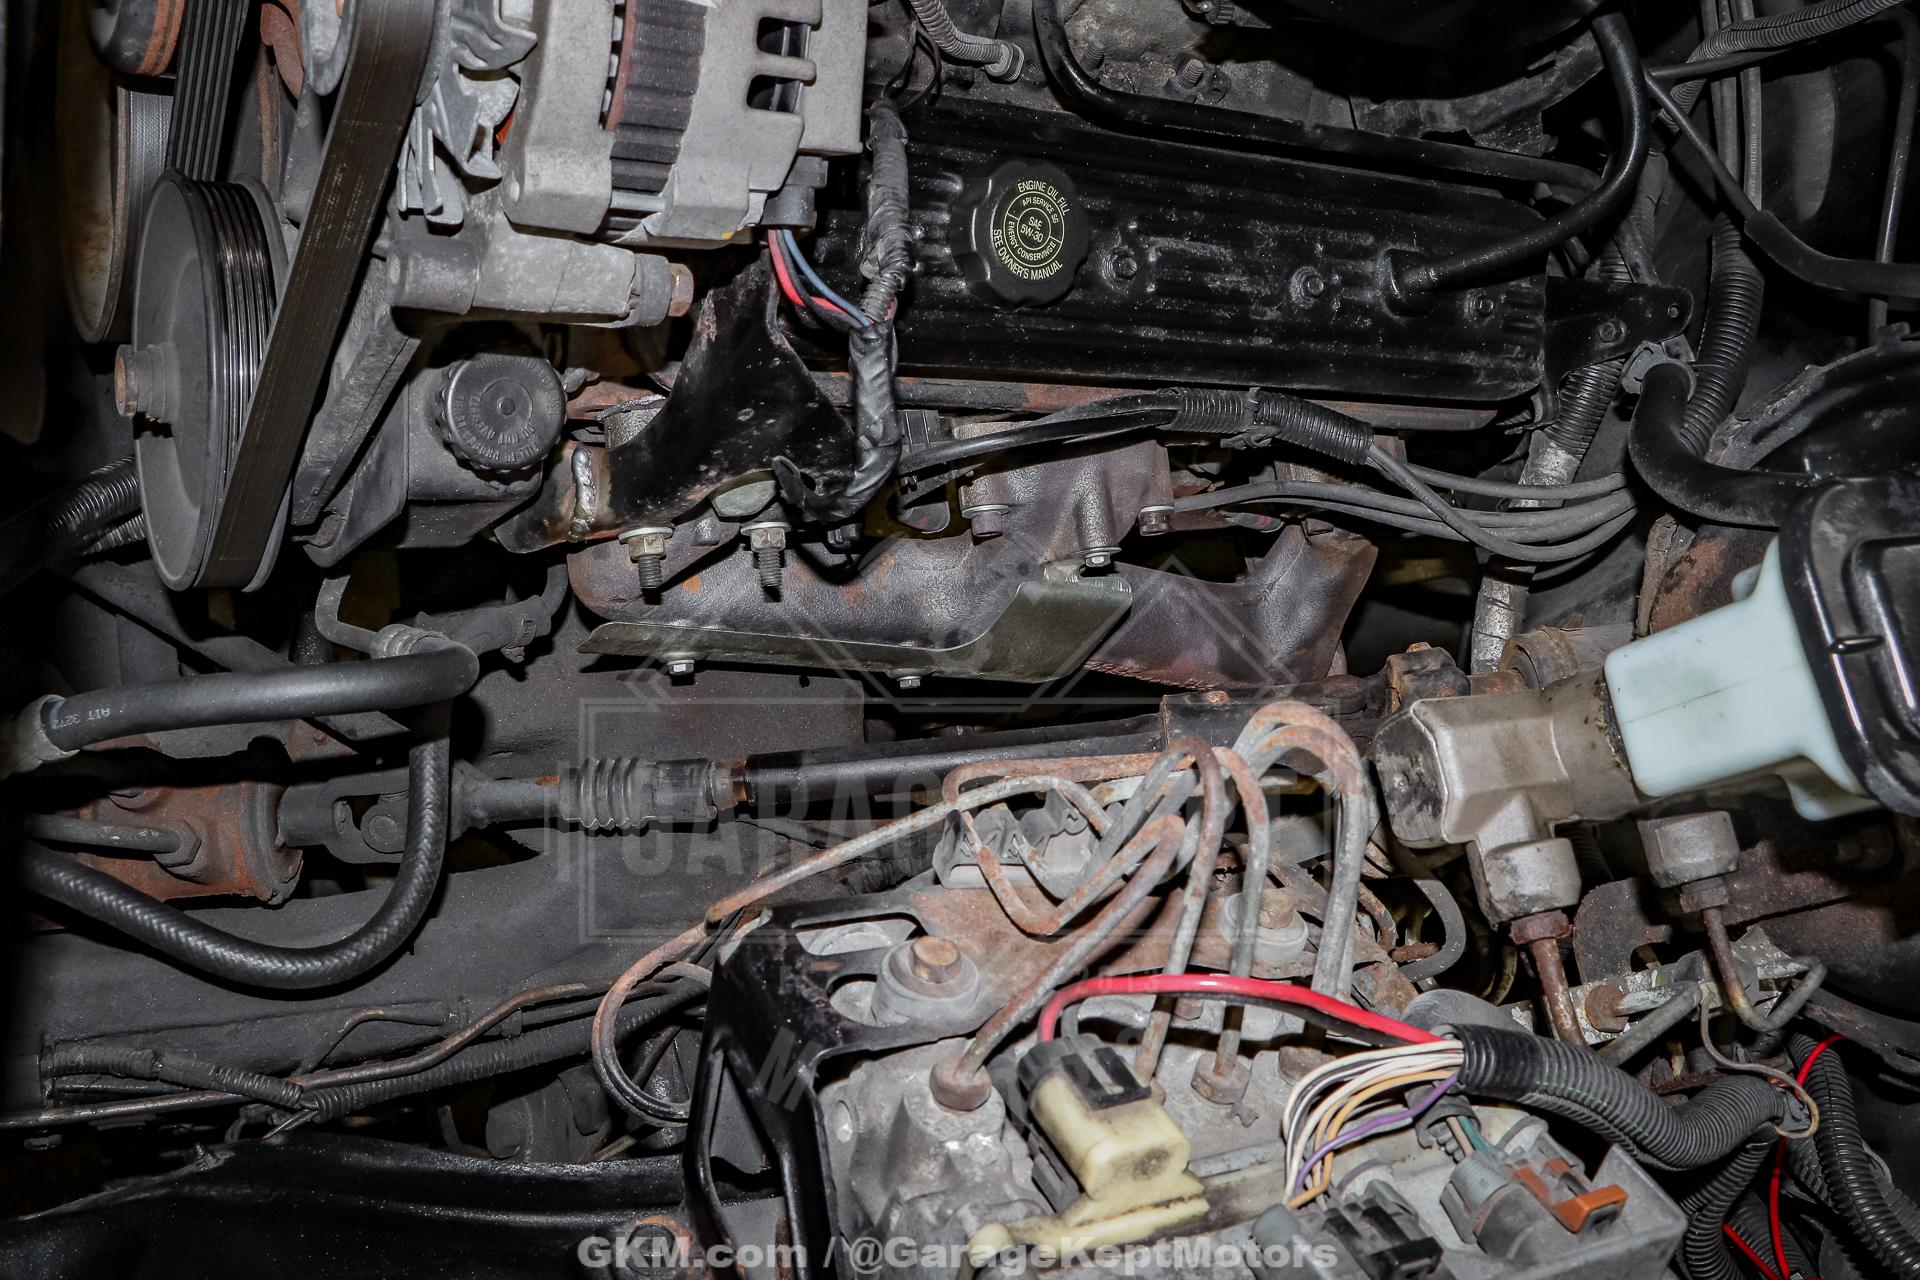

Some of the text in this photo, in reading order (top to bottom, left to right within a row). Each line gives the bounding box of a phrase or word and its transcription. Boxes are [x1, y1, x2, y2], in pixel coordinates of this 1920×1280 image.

[1017, 180, 1070, 217] ENGINE OIL FILL
[1022, 196, 1059, 224] API SERVICE SG
[1020, 224, 1044, 243] 5W-30
[1028, 216, 1043, 231] SAE
[993, 229, 1064, 281] SEE OWNER'S MANUAL
[1008, 220, 1019, 249] ENERGY
[1017, 245, 1053, 261] CONSERVING
